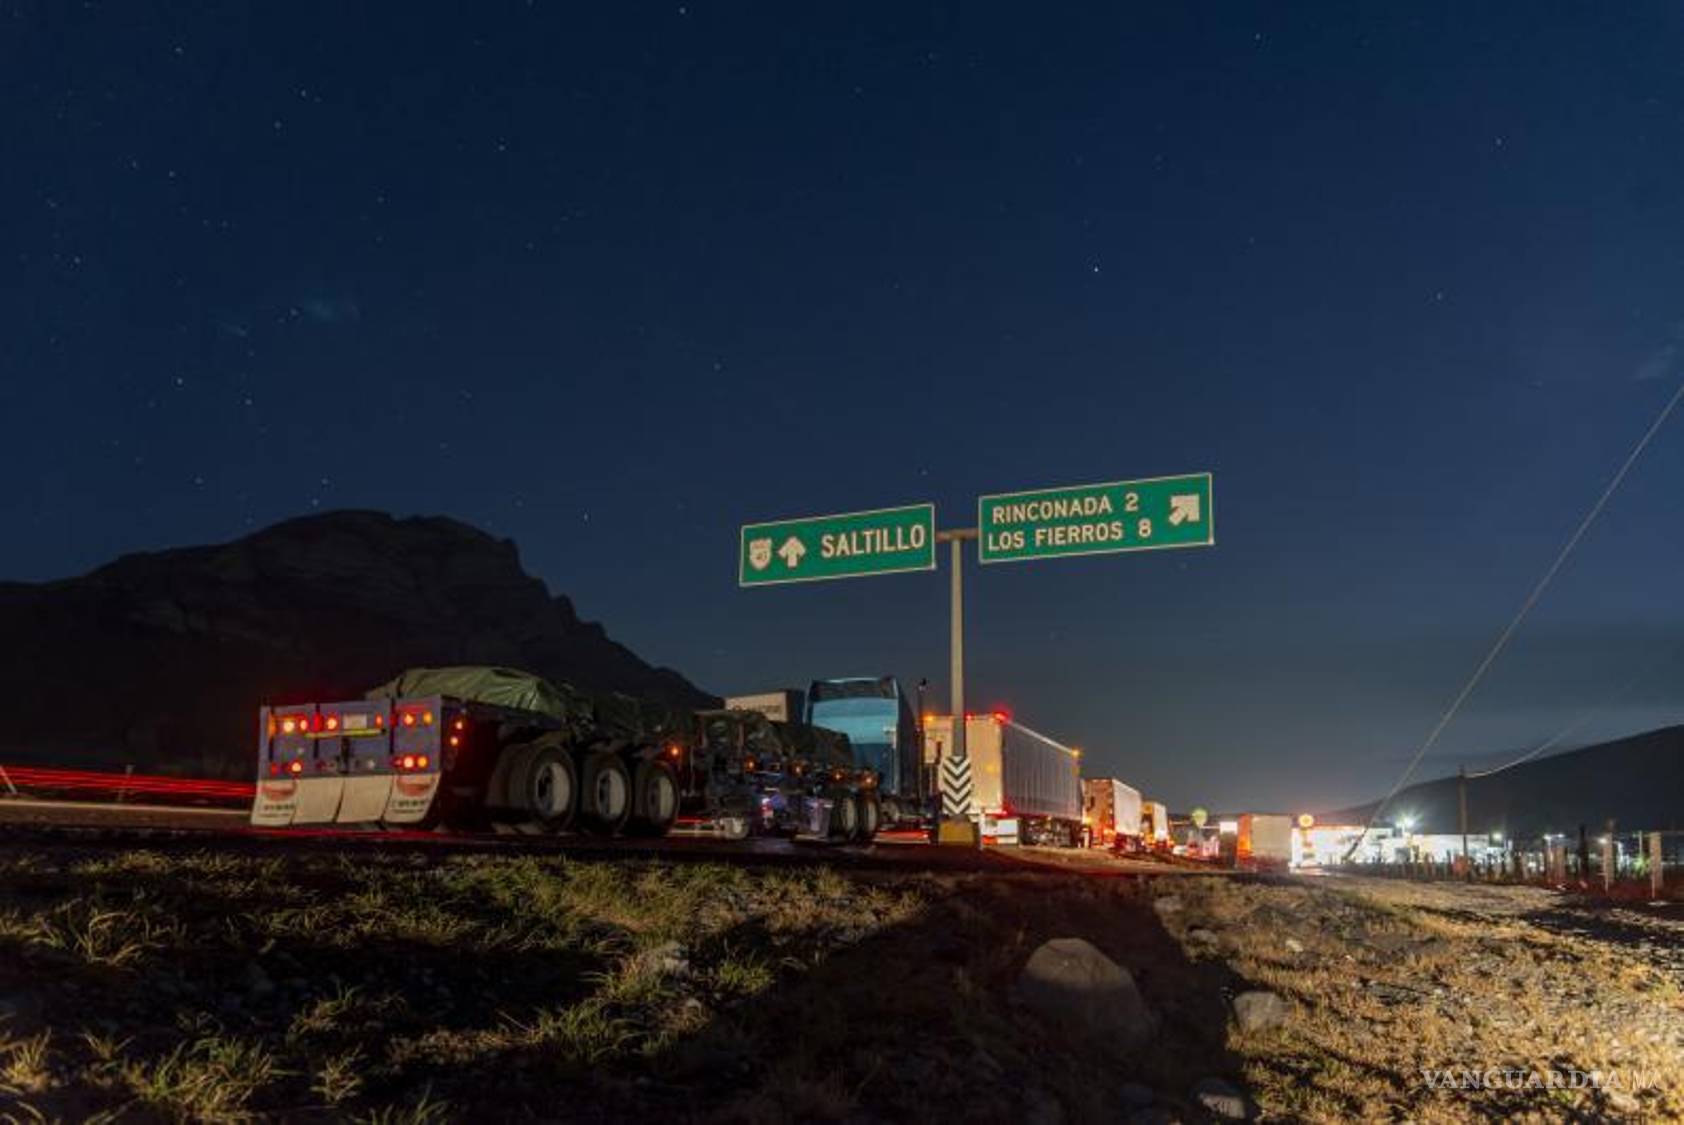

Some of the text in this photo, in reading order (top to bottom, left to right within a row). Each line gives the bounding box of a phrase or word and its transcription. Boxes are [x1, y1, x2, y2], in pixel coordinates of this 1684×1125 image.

[992, 492, 1140, 525] RINCONADA 2
[821, 524, 926, 558] SALTILLO
[988, 518, 1152, 551] LOS FIERROS 8
